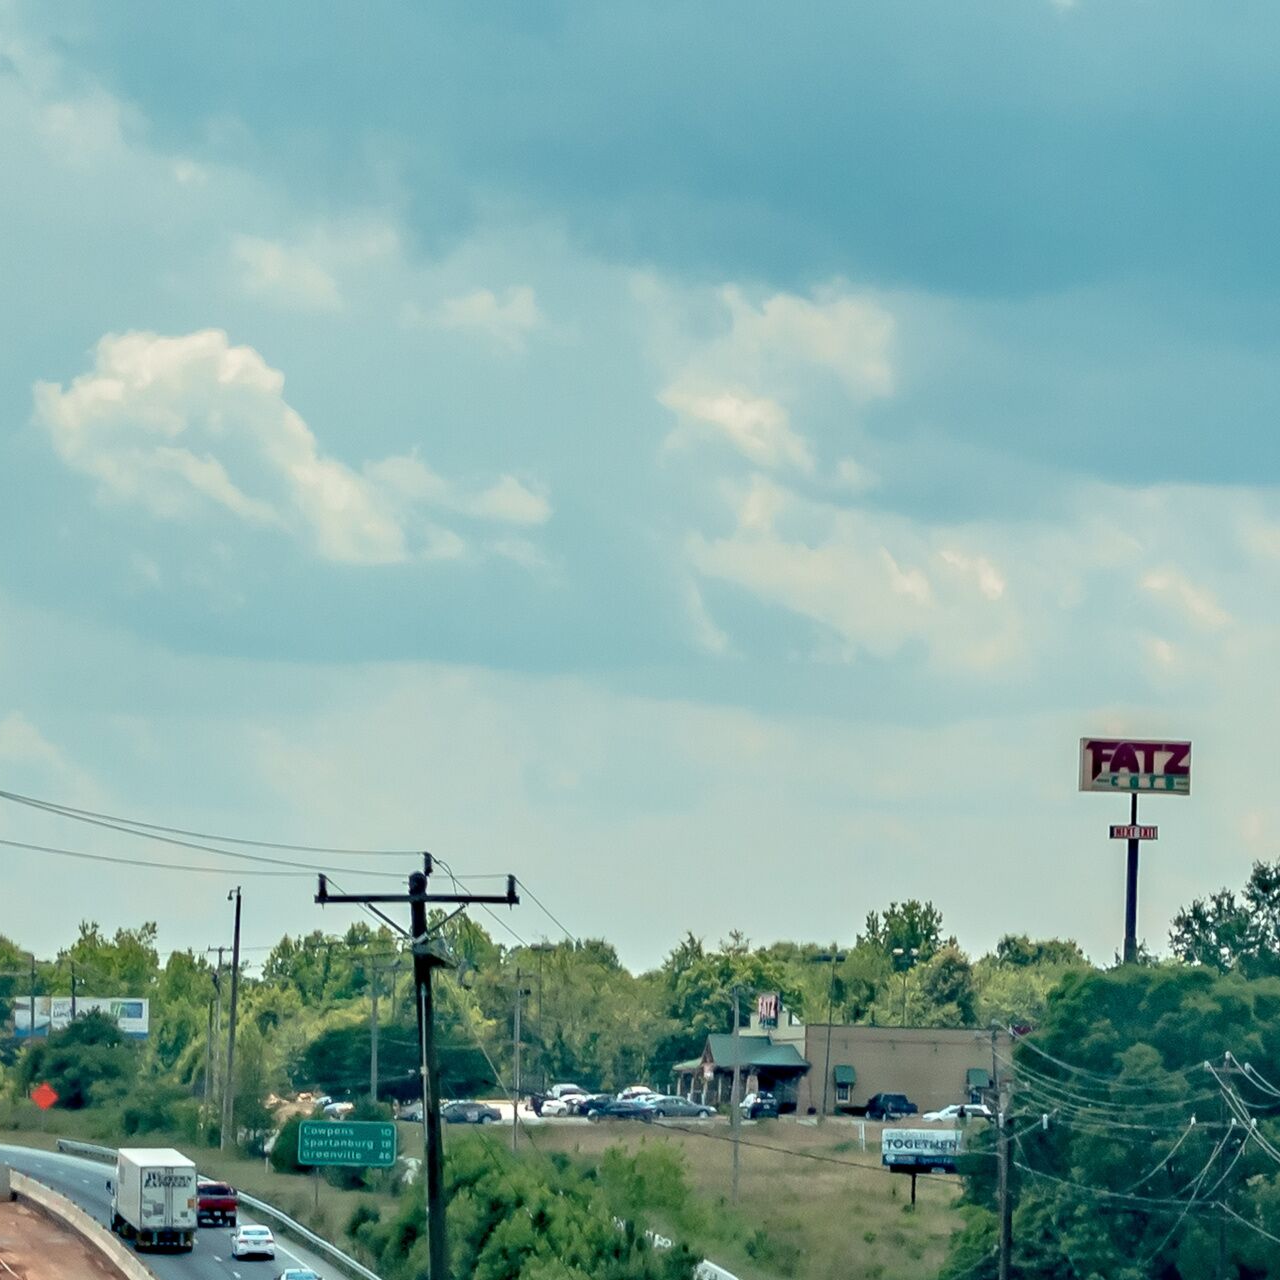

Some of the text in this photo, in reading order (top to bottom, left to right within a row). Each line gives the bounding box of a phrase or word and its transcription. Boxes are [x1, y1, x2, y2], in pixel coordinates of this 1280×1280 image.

[1086, 741, 1190, 780] FATZ
[303, 1126, 392, 1136] Cowpens 10
[303, 1139, 374, 1150] Spartanburg
[885, 1140, 958, 1150] TOGETHER
[303, 1151, 362, 1160] Greenville
